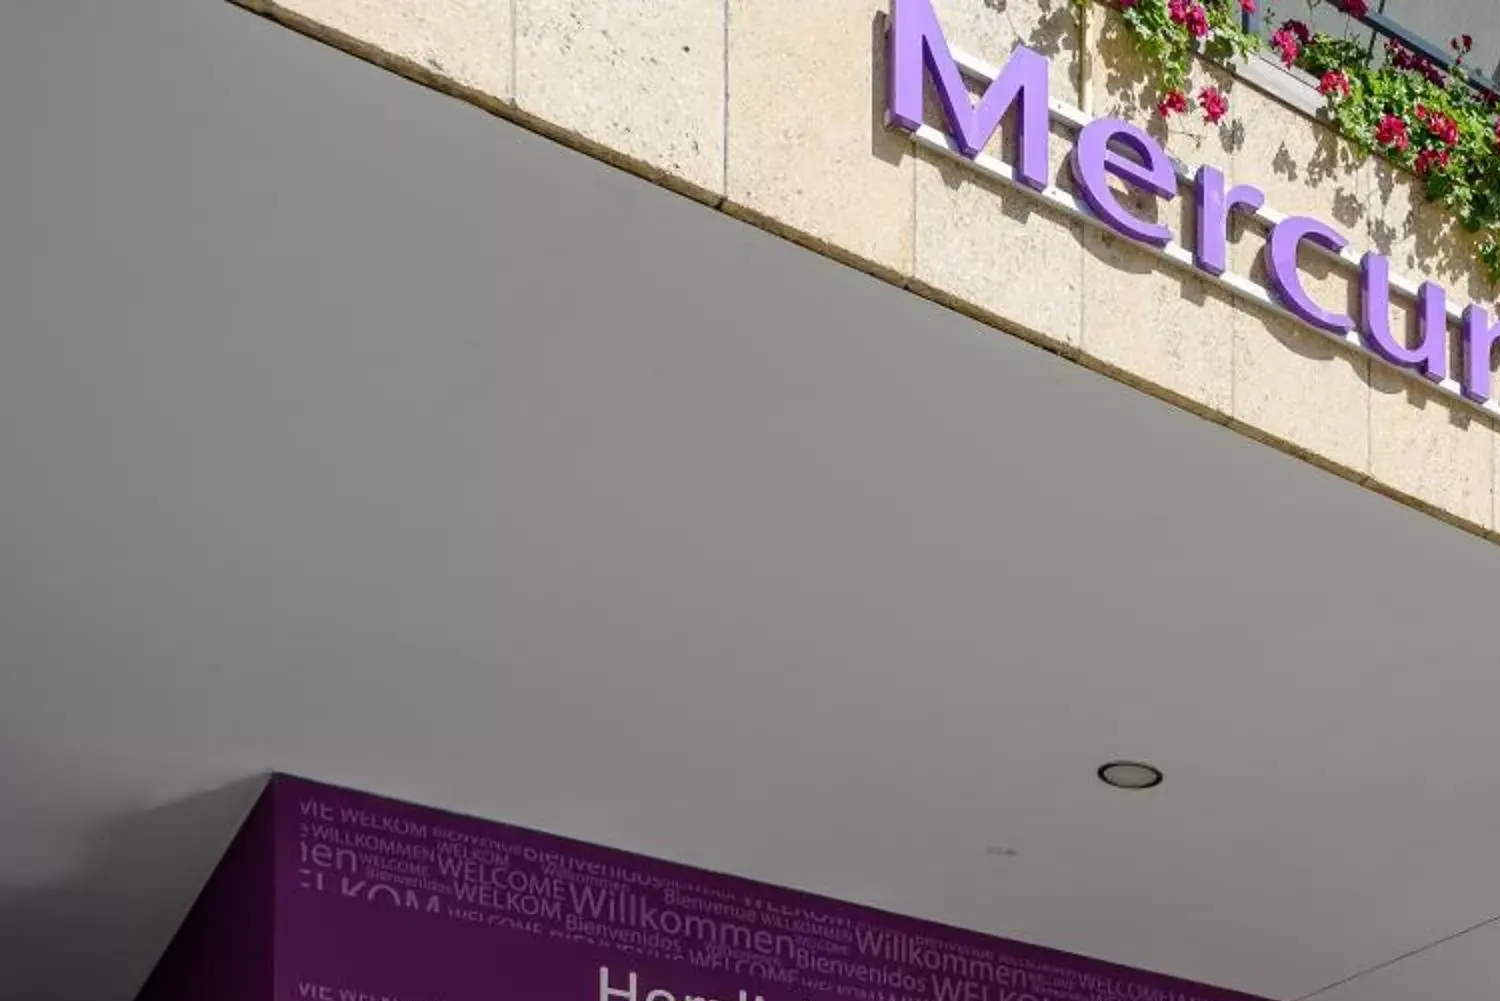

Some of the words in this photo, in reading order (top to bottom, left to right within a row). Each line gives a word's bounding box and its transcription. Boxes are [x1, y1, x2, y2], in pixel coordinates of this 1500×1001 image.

[312, 824, 436, 863] WILLKOMMEN
[438, 856, 568, 901] WELCOME
[452, 880, 563, 922] WELKOM
[565, 913, 683, 953] Bienvenidos
[568, 880, 796, 960] Willkommen
[797, 946, 928, 994] Bienvenidos
[855, 925, 1029, 989] Willkommen
